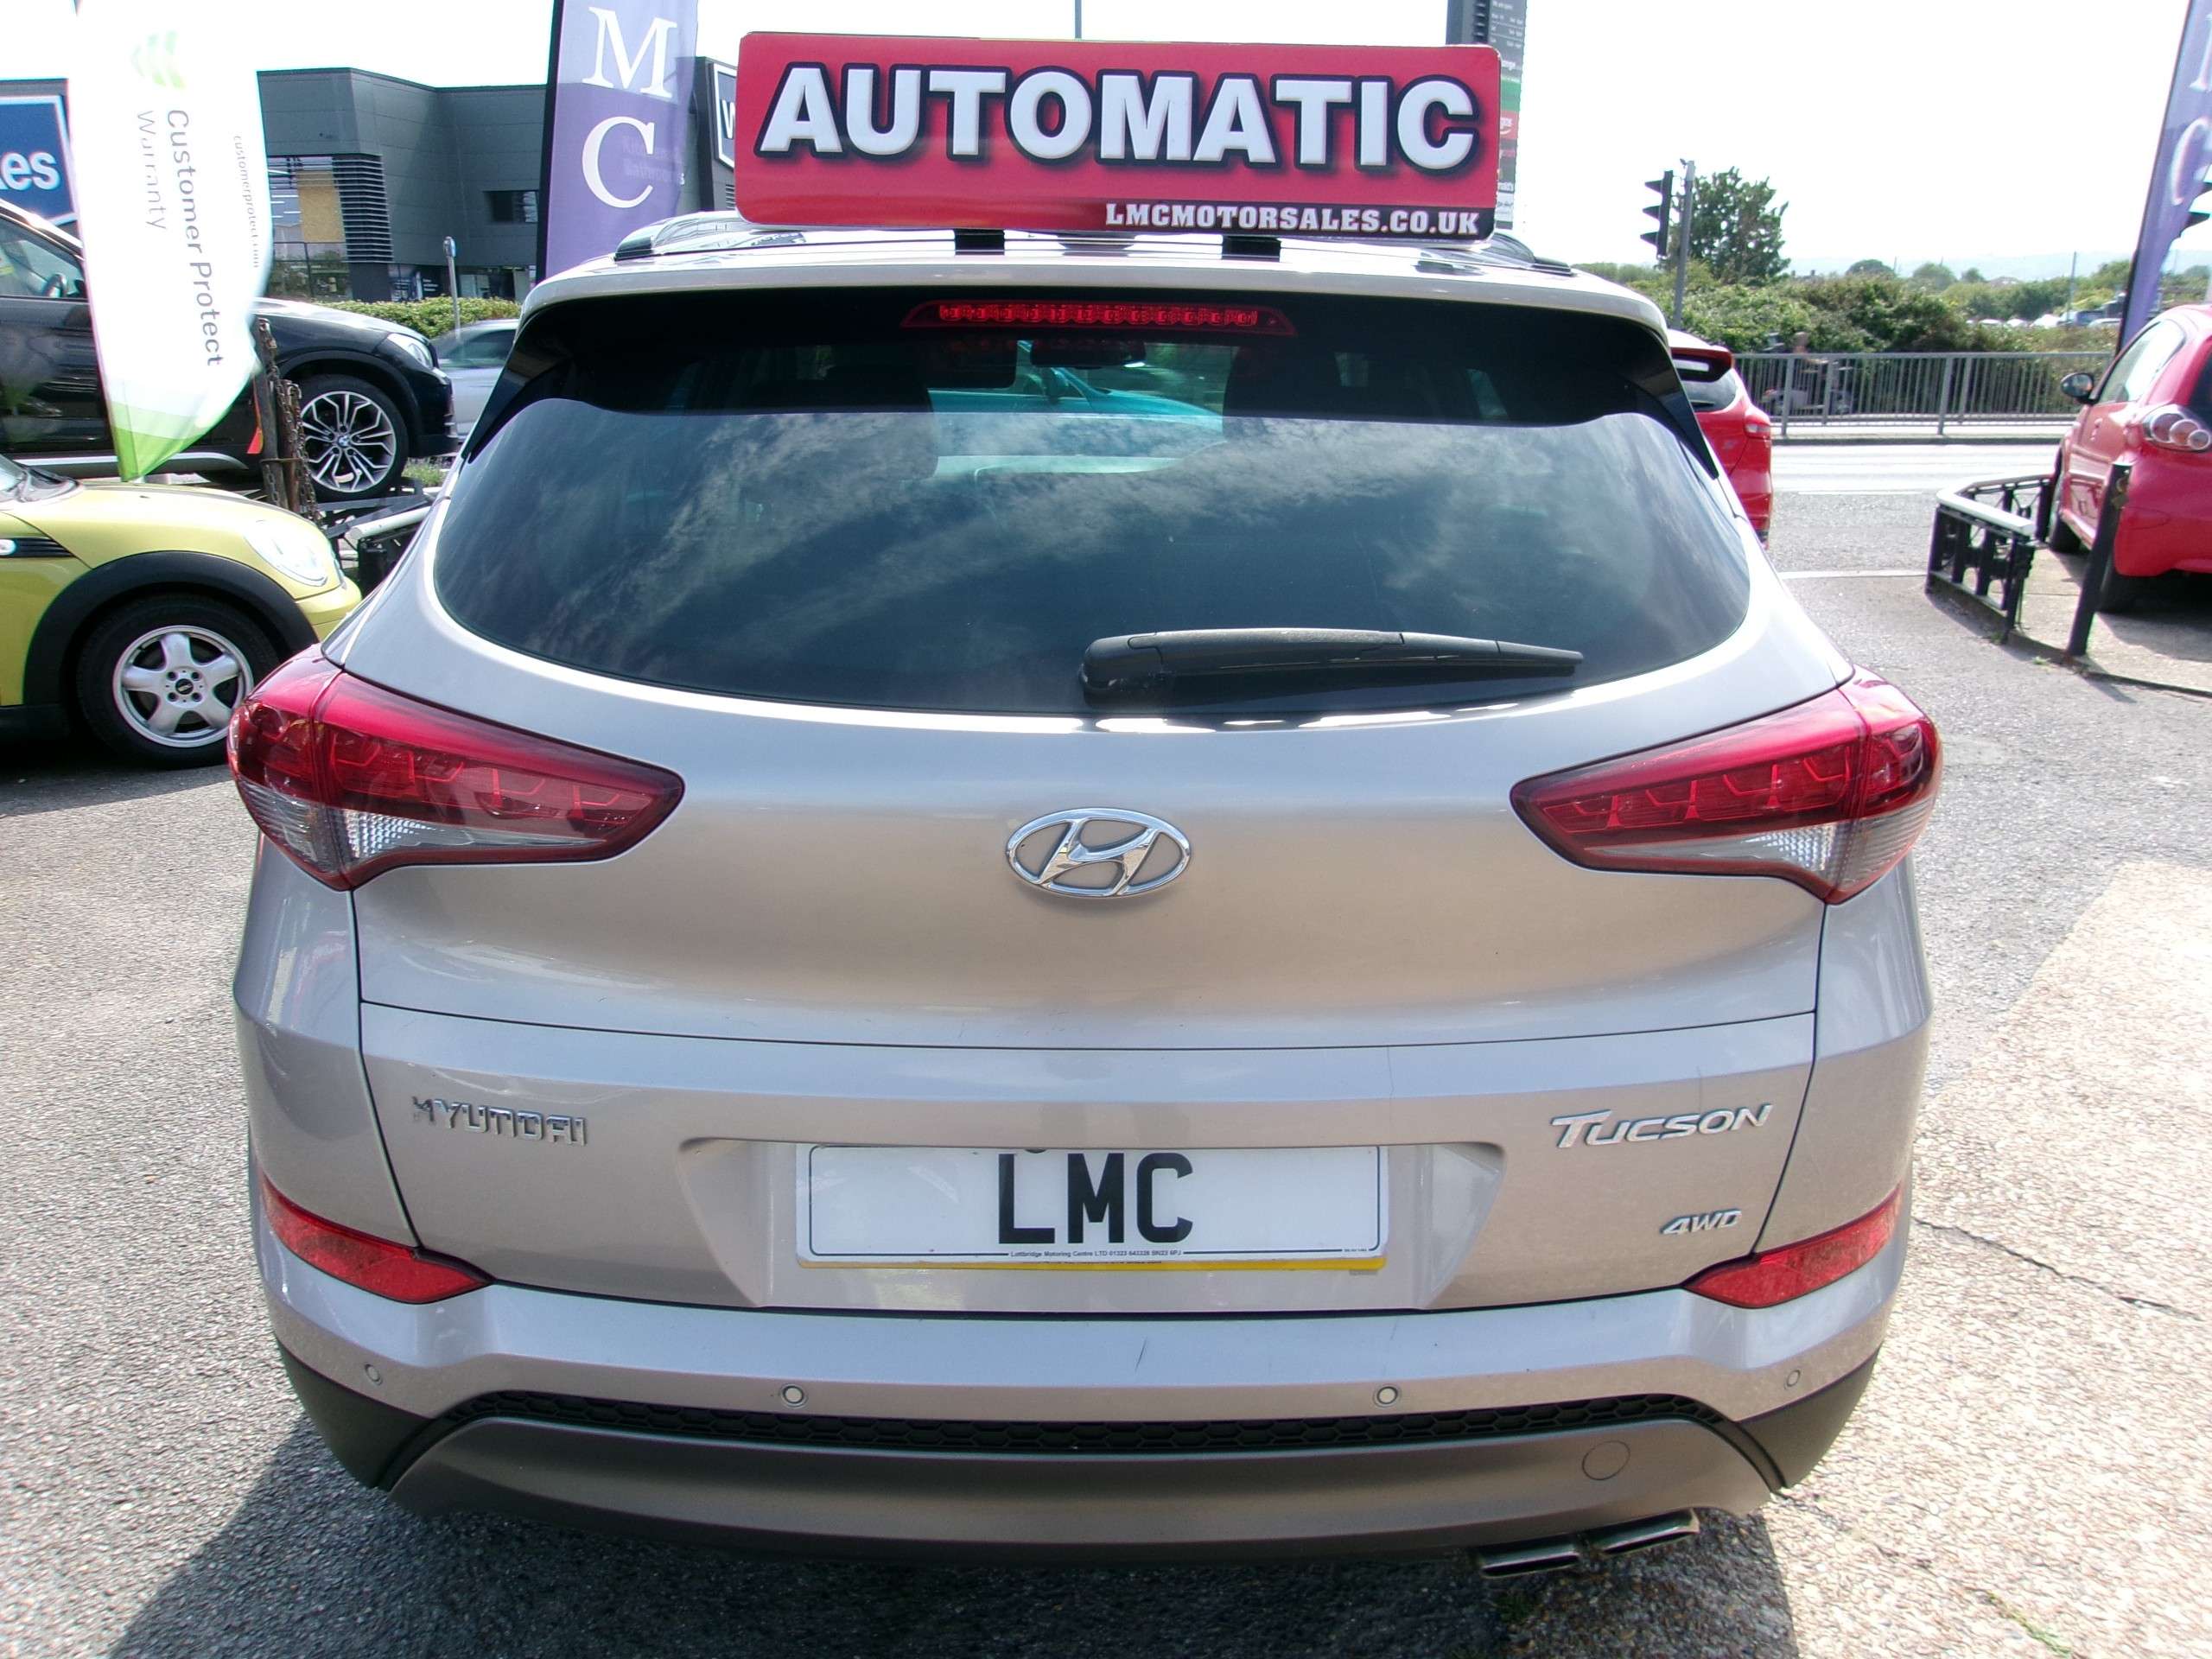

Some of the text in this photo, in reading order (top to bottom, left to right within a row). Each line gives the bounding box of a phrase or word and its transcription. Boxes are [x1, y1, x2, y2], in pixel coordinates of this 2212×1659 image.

[758, 66, 1477, 172] AUTOMATIC
[0, 152, 60, 191] es
[167, 110, 223, 366] Customer Protect
[1105, 203, 1480, 236] LMCMOTORSALES.CO.UK
[411, 1096, 588, 1147] HYUNDAI
[1550, 1103, 1774, 1148] TUCSON
[998, 1152, 1193, 1244] LMC
[1659, 1208, 1743, 1236] 4WD
